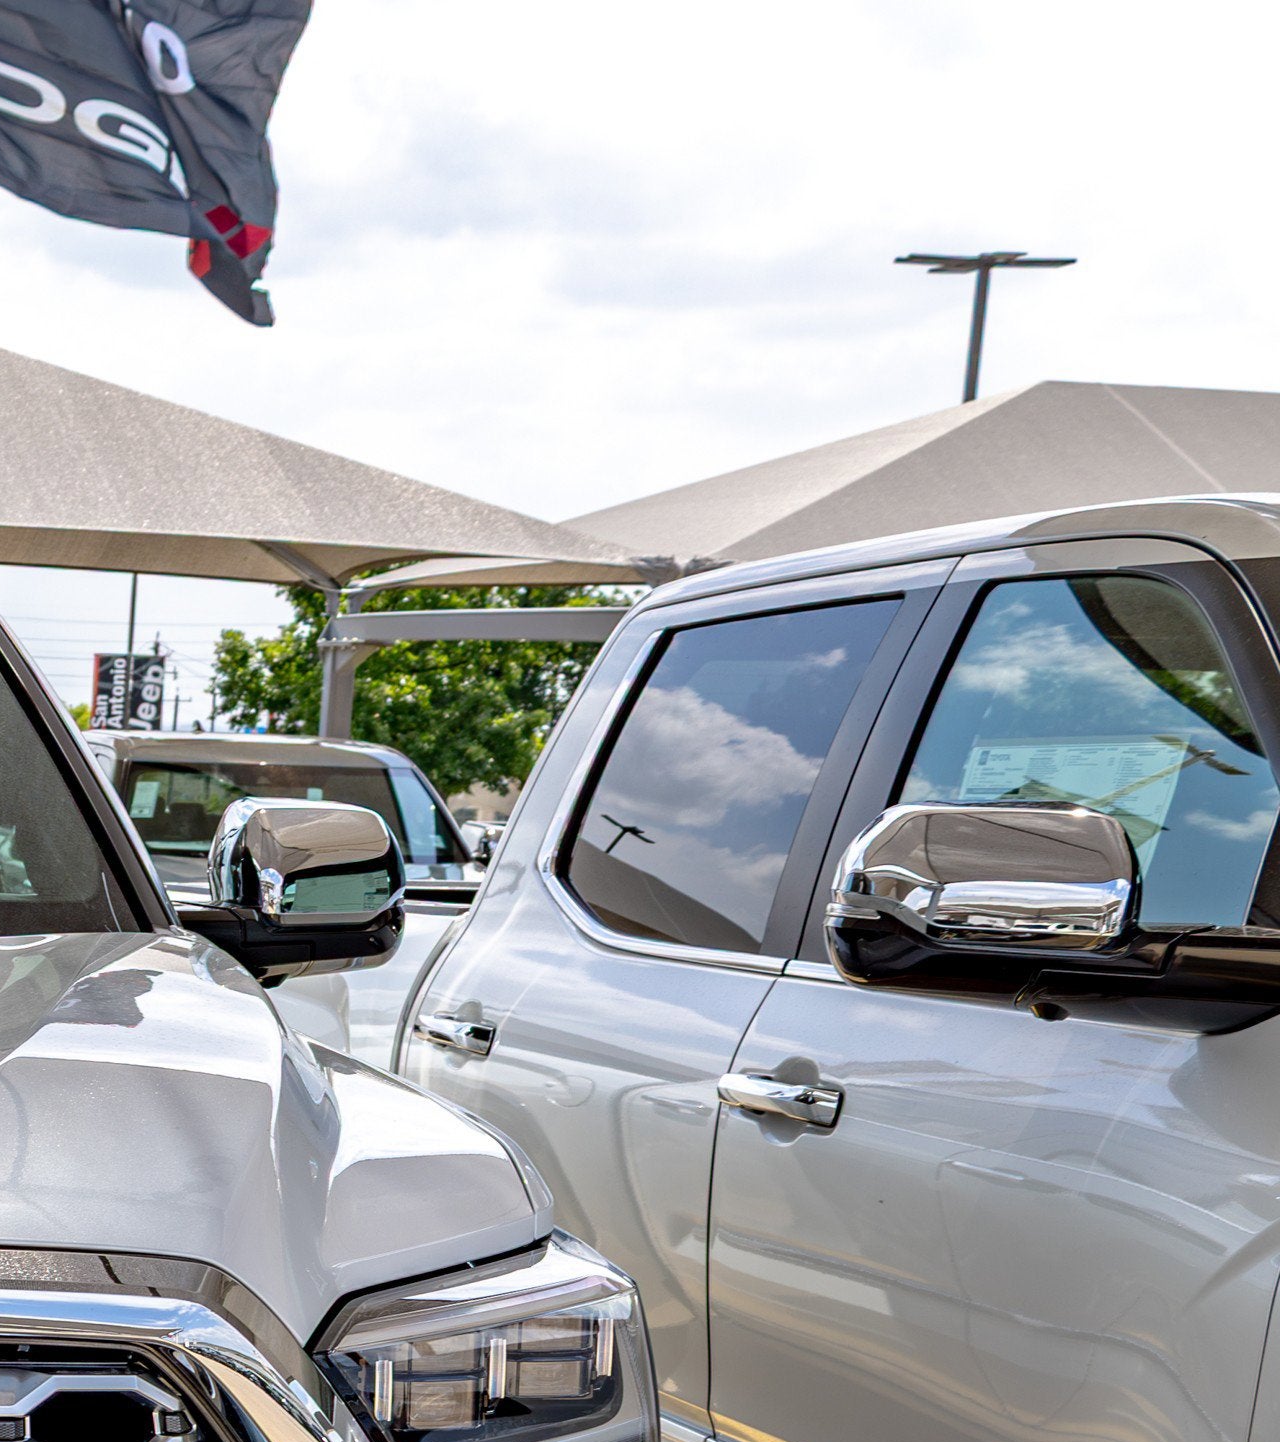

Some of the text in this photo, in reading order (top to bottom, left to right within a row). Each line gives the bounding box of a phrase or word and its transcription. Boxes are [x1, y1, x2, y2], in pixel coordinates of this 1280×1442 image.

[91, 694, 108, 727] San
[106, 658, 127, 729] Antonio
[128, 665, 164, 731] Jeep
